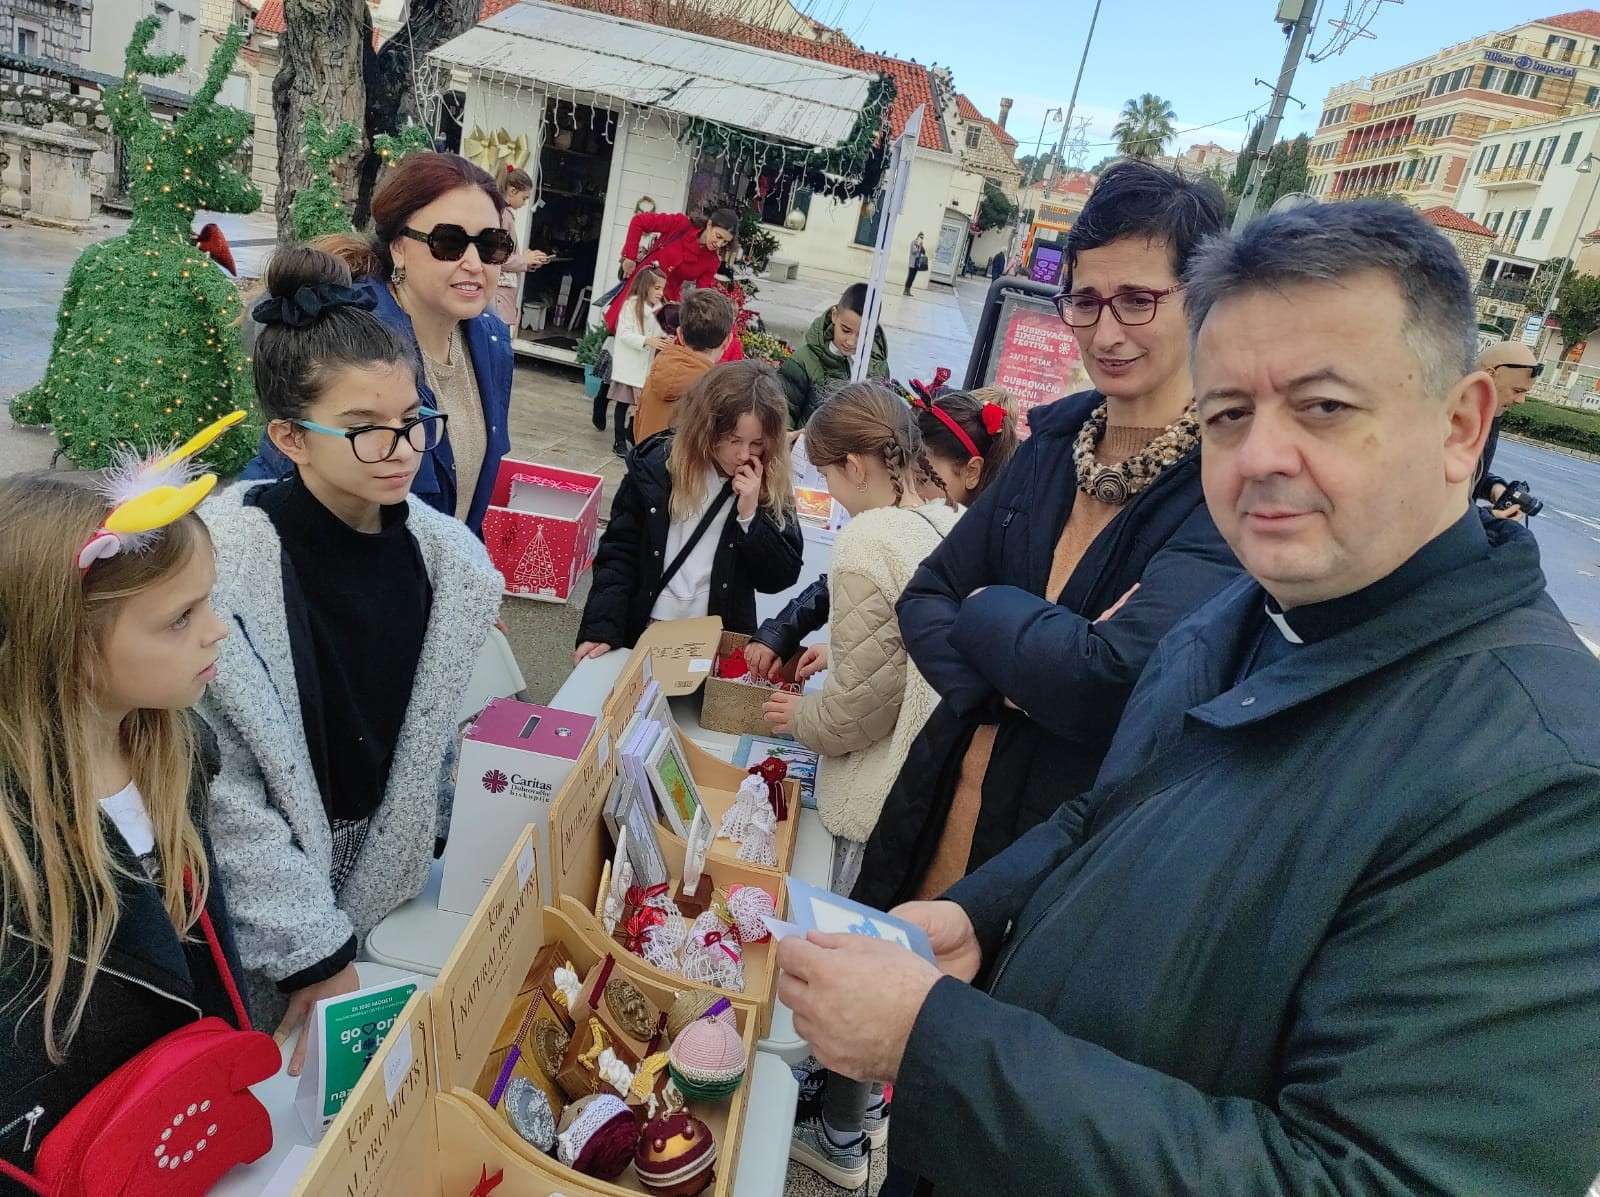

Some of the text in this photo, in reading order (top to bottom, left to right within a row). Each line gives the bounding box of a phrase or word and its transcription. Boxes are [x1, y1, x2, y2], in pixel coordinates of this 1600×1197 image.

[1013, 338, 1055, 353] FESTIVAL
[1003, 375, 1060, 394] DUBROVAČKI
[510, 773, 552, 790] Caritas
[458, 946, 497, 1024] NATURAL
